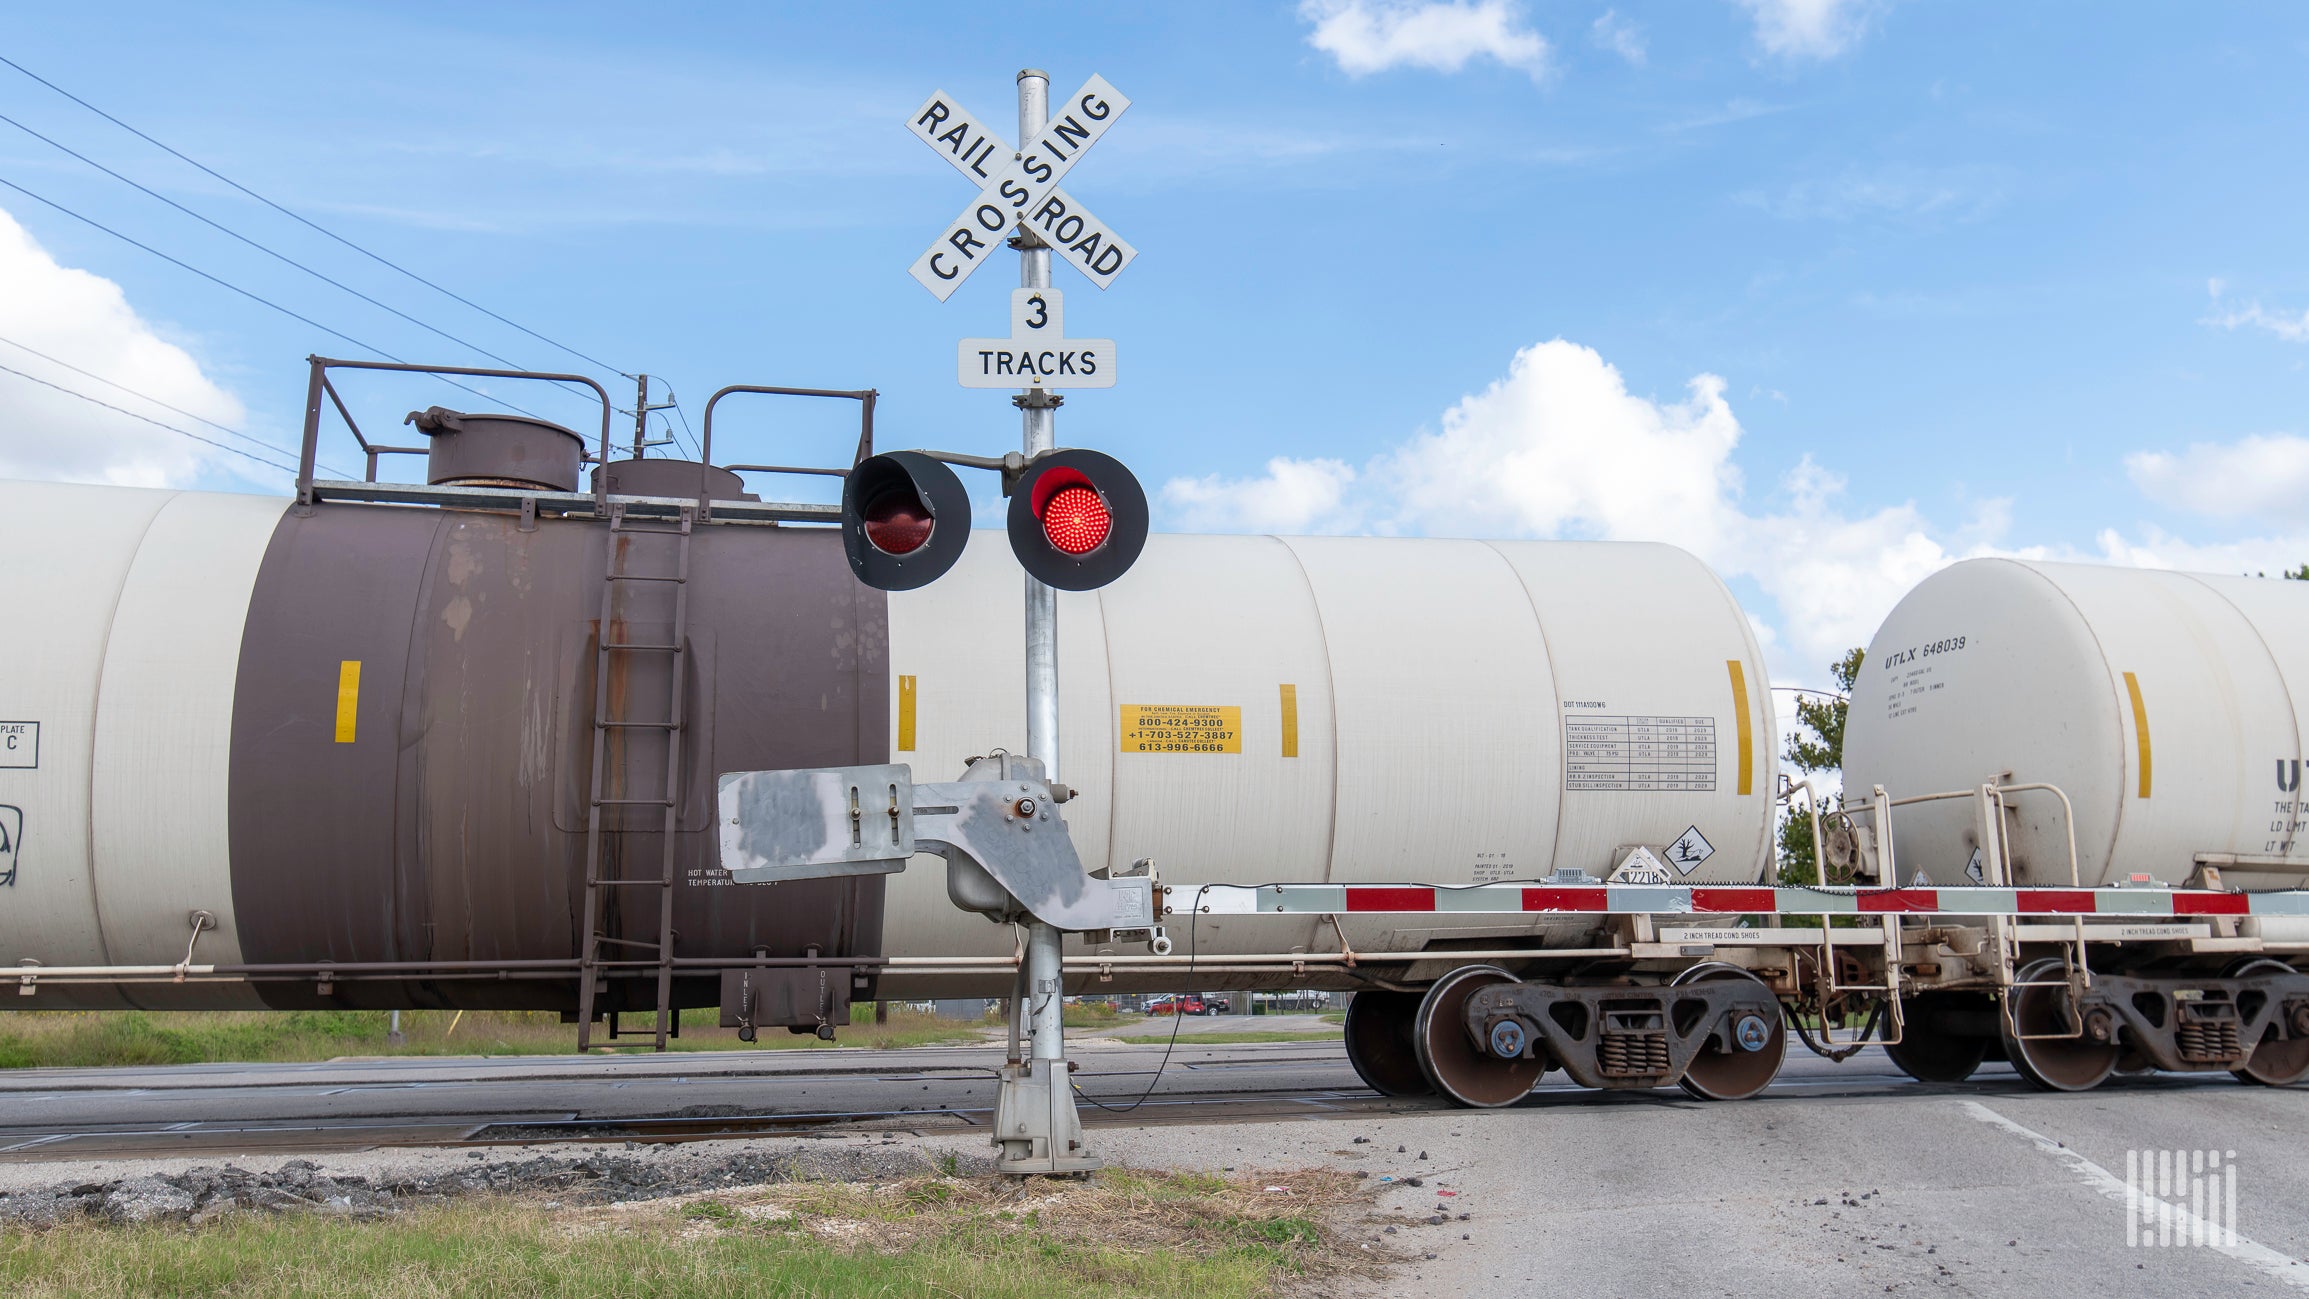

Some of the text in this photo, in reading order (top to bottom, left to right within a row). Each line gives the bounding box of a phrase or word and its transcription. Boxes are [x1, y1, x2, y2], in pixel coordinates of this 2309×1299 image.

[917, 100, 1123, 276] RAIL ROAD
[929, 93, 1111, 280] CROSSING
[1025, 296, 1048, 329] 3
[978, 351, 1097, 376] TRACKS
[1885, 636, 1966, 670] UTLX 648039
[1139, 718, 1223, 727] 800-424-9300
[1, 725, 25, 733] PLATE
[1129, 731, 1233, 739] +1-703-527-3887
[7, 735, 17, 750] C
[1139, 743, 1224, 751] 613-996-6666
[2276, 759, 2309, 792] U
[2275, 802, 2292, 813] THE
[2270, 821, 2307, 832] LD LMT
[2265, 841, 2276, 852] LT
[1630, 872, 1659, 884] 2218
